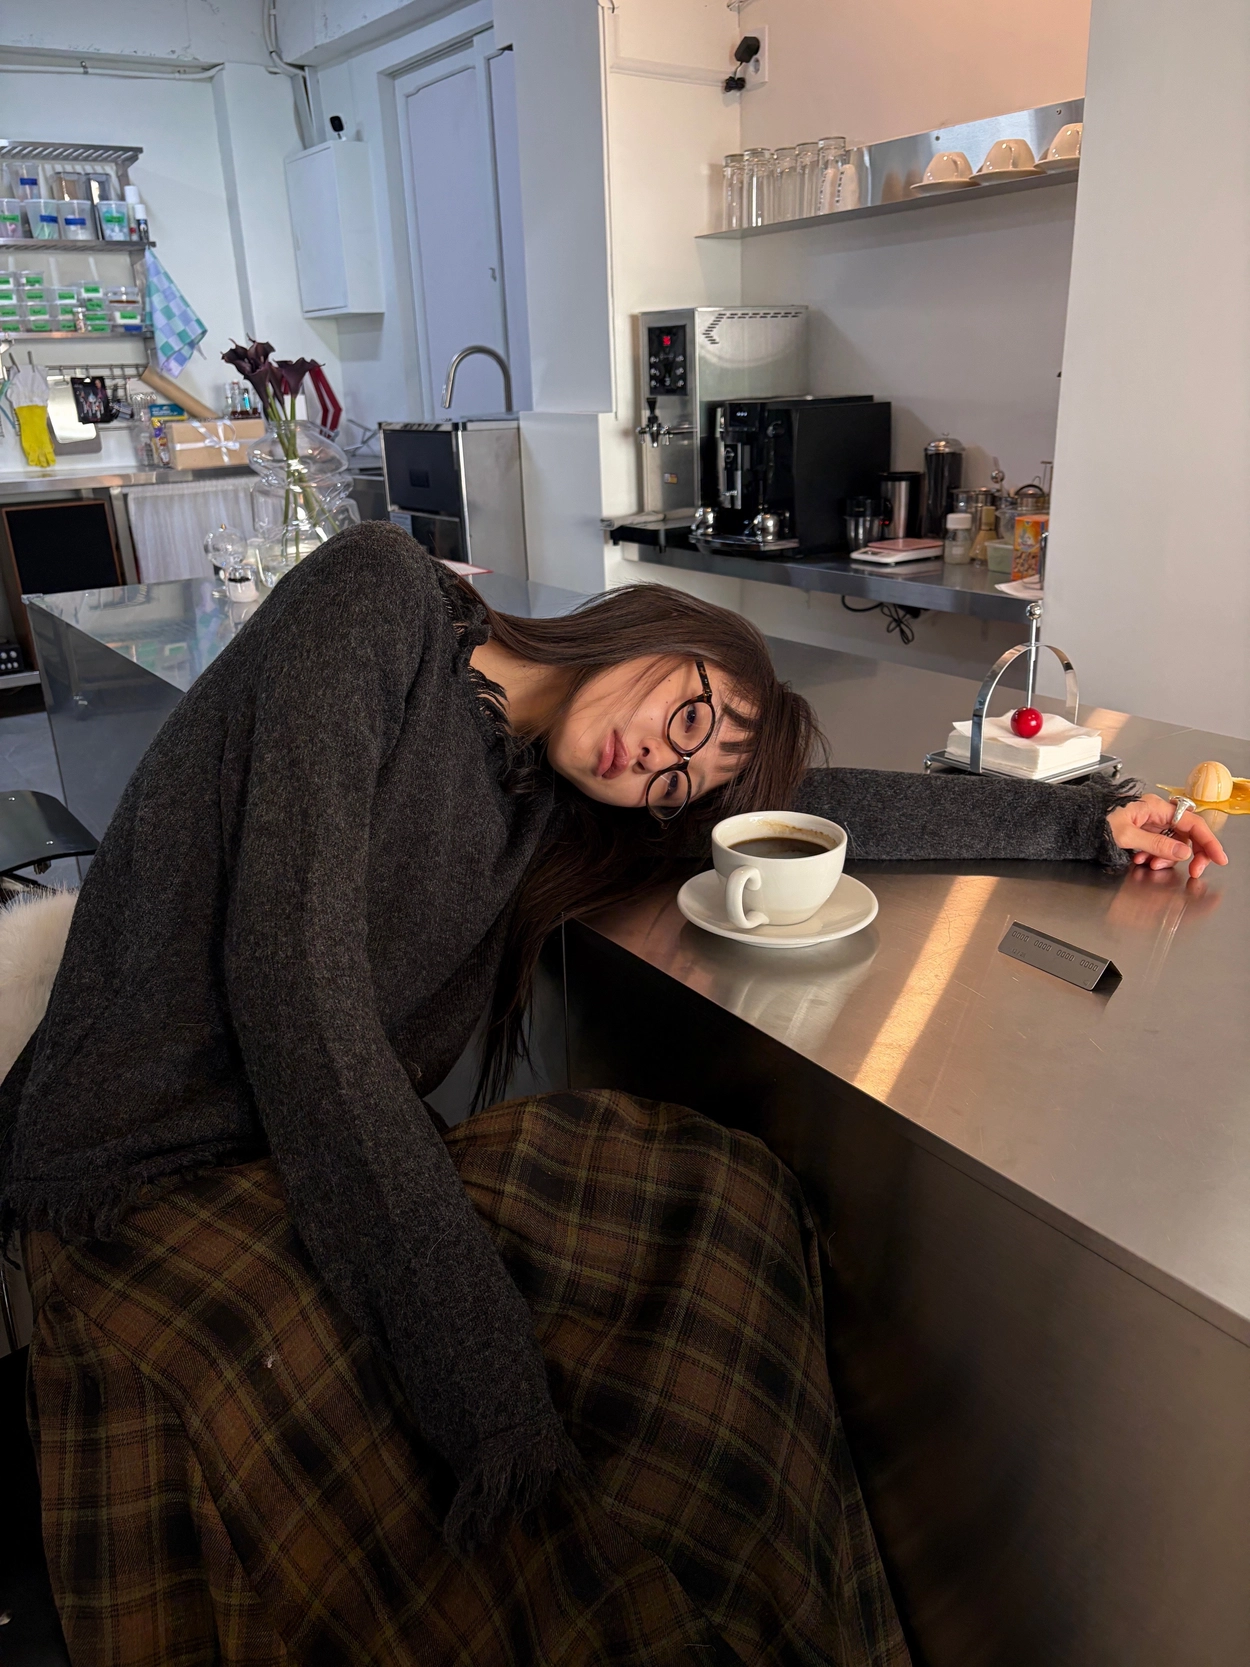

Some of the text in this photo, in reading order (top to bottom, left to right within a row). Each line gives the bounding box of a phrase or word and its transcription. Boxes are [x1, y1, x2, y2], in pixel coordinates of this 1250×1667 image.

[1011, 930, 1099, 972] 0000 0000 0000 0000
